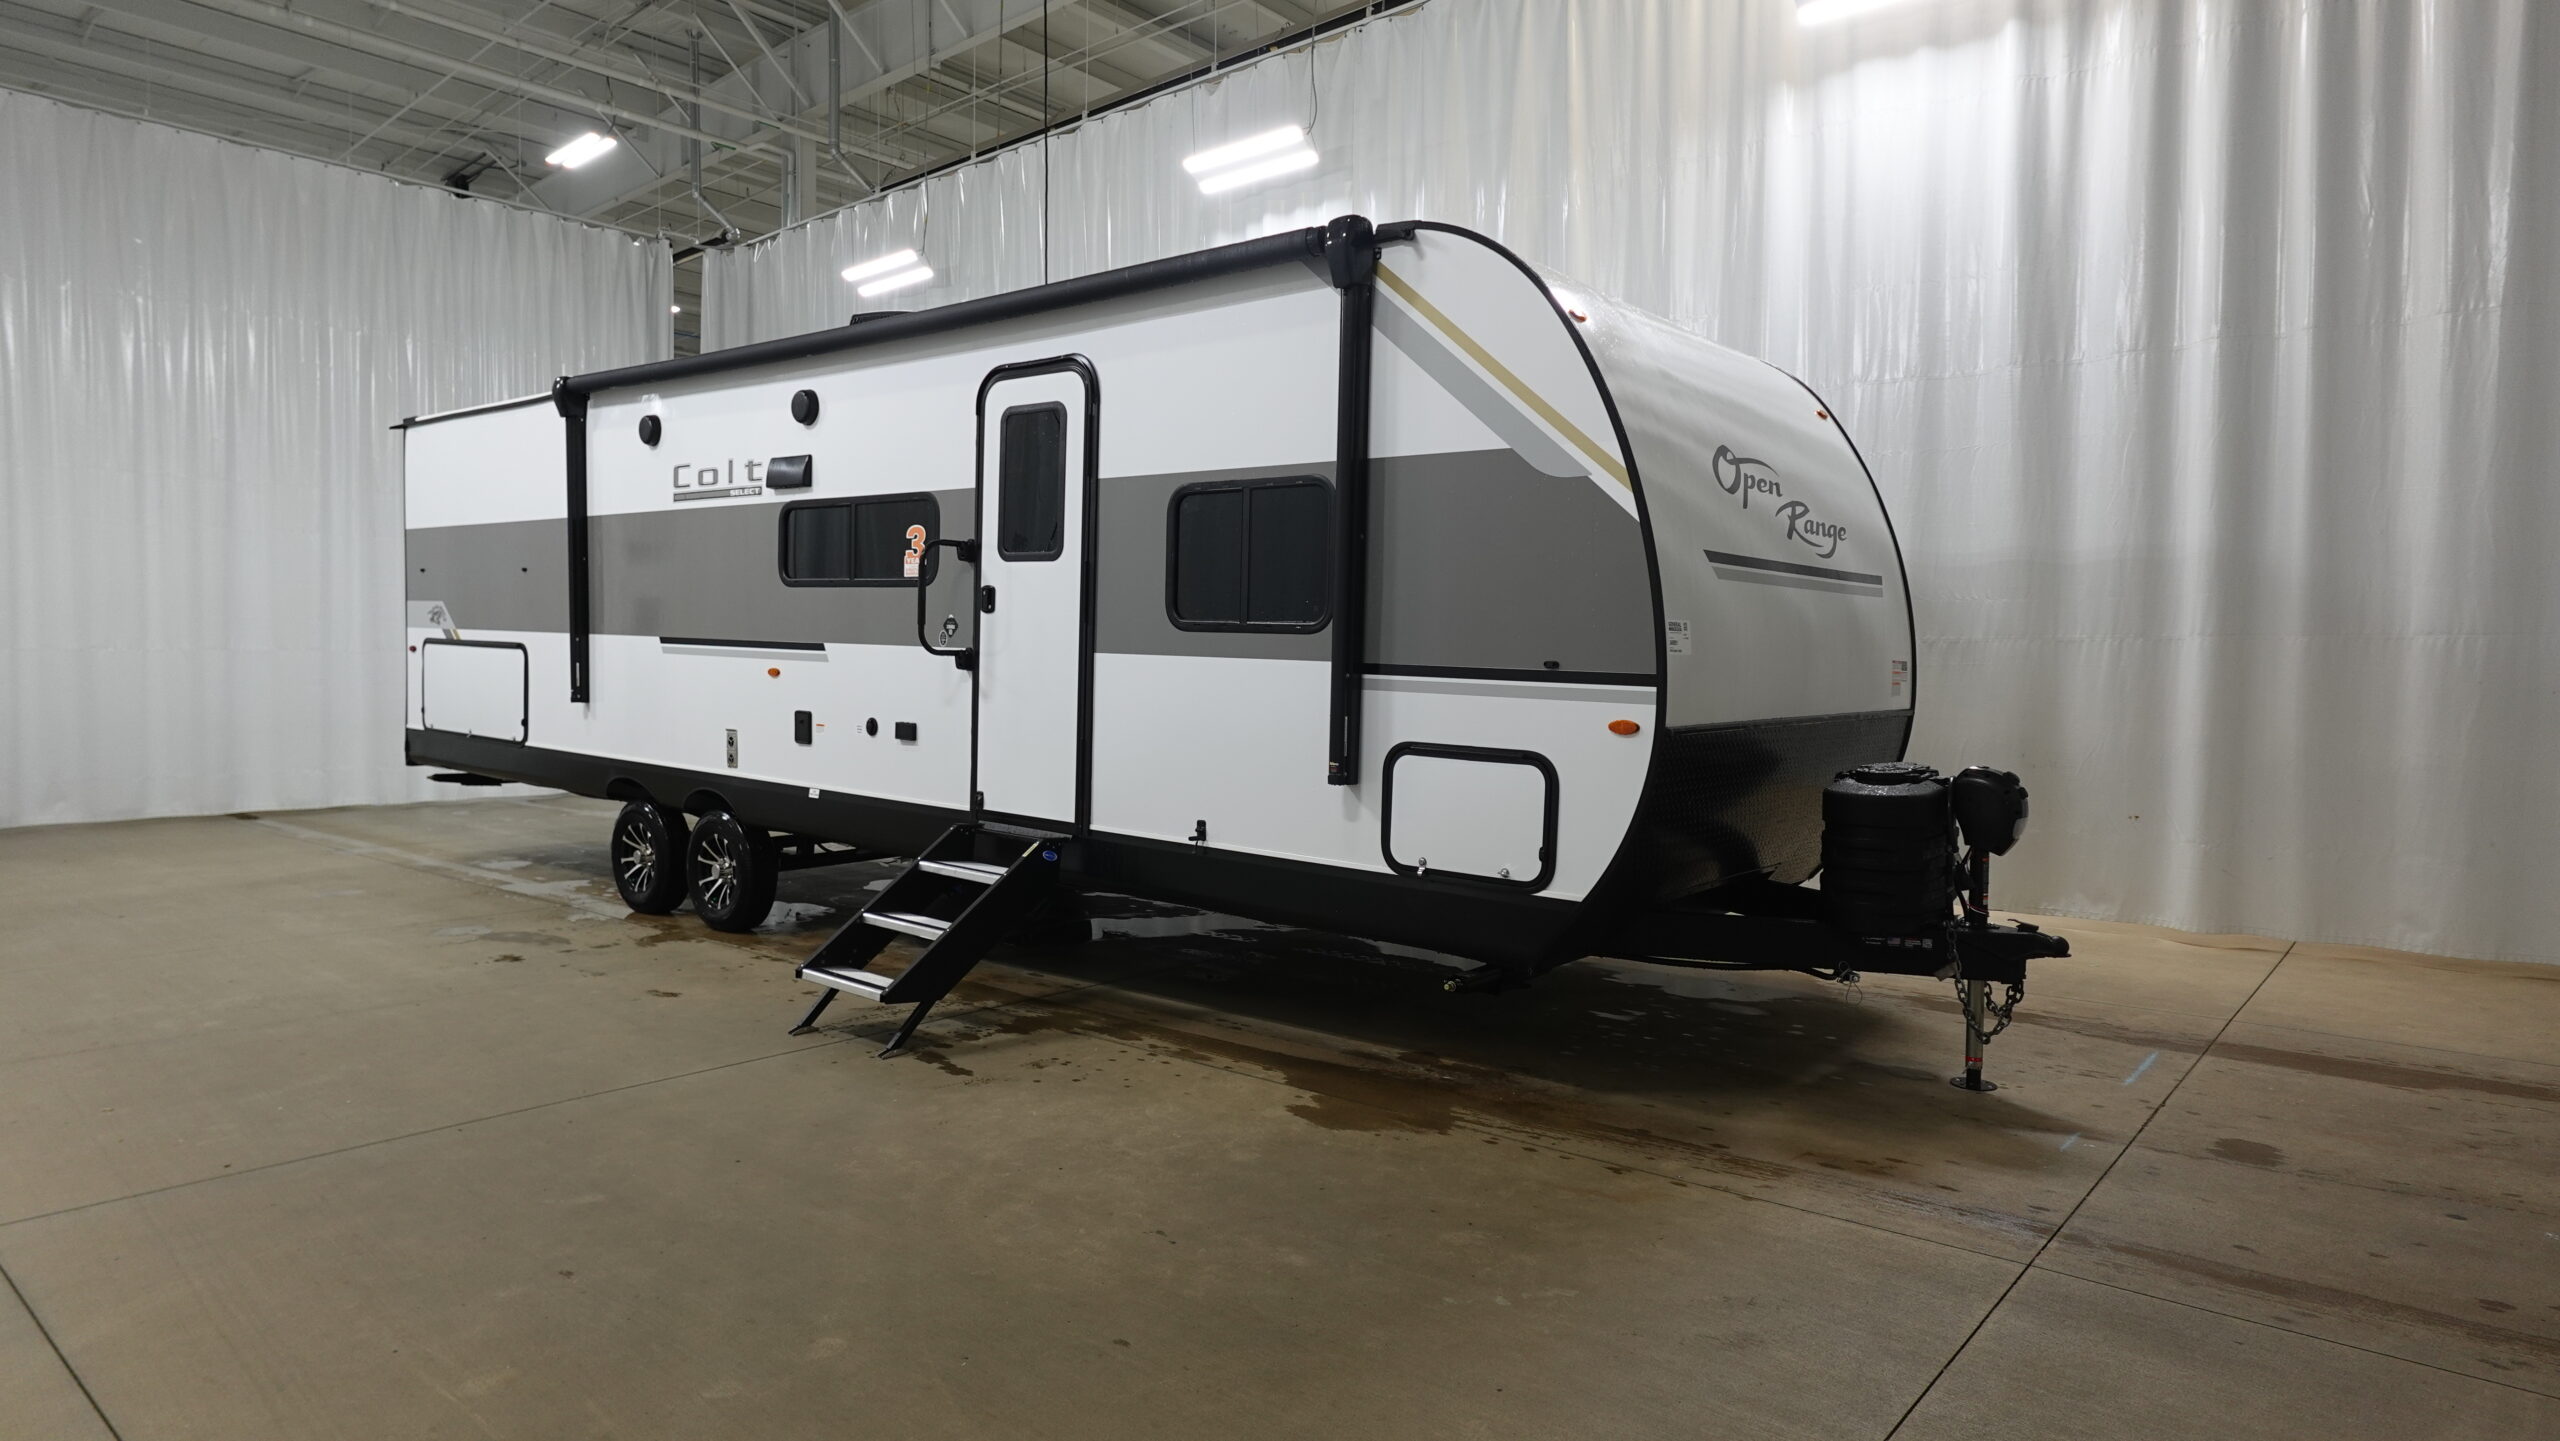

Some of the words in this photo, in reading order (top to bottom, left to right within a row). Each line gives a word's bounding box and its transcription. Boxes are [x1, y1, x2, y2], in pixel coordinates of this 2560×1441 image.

[674, 460, 762, 488] Colt
[1712, 445, 1783, 509] Open
[729, 487, 761, 497] SELECT
[906, 524, 926, 558] 3
[1775, 500, 1847, 559] Range
